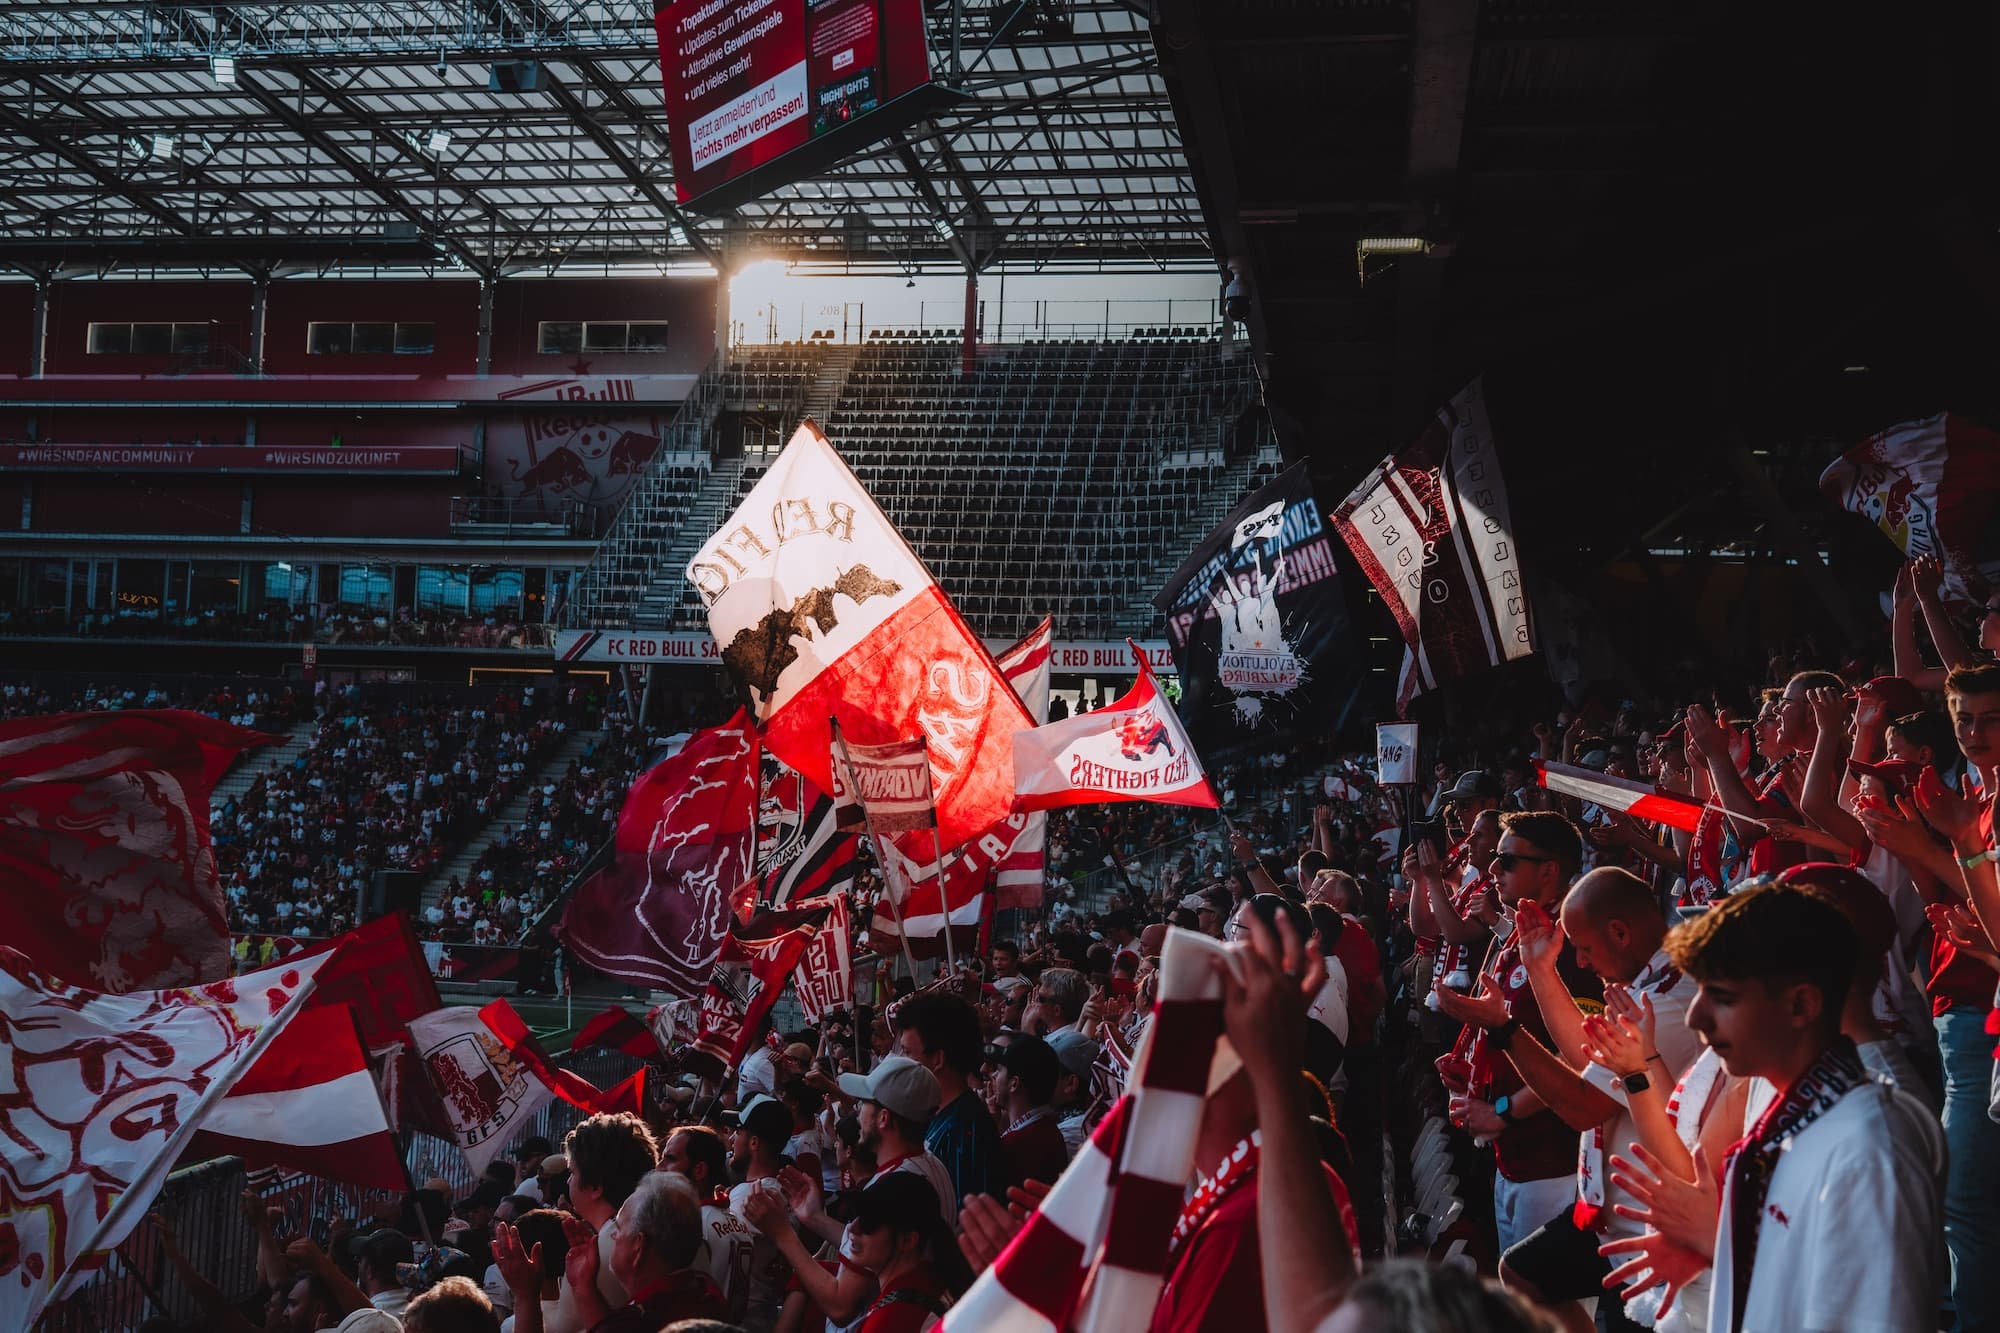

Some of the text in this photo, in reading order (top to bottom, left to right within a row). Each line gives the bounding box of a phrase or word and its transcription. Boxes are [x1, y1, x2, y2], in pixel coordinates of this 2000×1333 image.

[684, 27, 717, 55] Updates
[718, 15, 735, 36] zum
[688, 46, 724, 78] Attraktive
[723, 11, 783, 56] Gewinnspiele
[690, 52, 753, 100] und vieles mehr!
[692, 84, 776, 143] Jetzt anmelden und
[695, 92, 804, 163] nichts mehr verpassen!
[17, 450, 195, 464] #WIRSINDFANCOMMUNITY
[265, 451, 401, 465] #WIRSINDZUKUNFT
[608, 639, 625, 656] FC
[629, 639, 657, 657] RED
[662, 640, 695, 658] BULL
[1063, 650, 1089, 666] RED
[1094, 650, 1126, 666] BULL
[1693, 851, 1702, 870] FC
[466, 1111, 506, 1146] GFS
